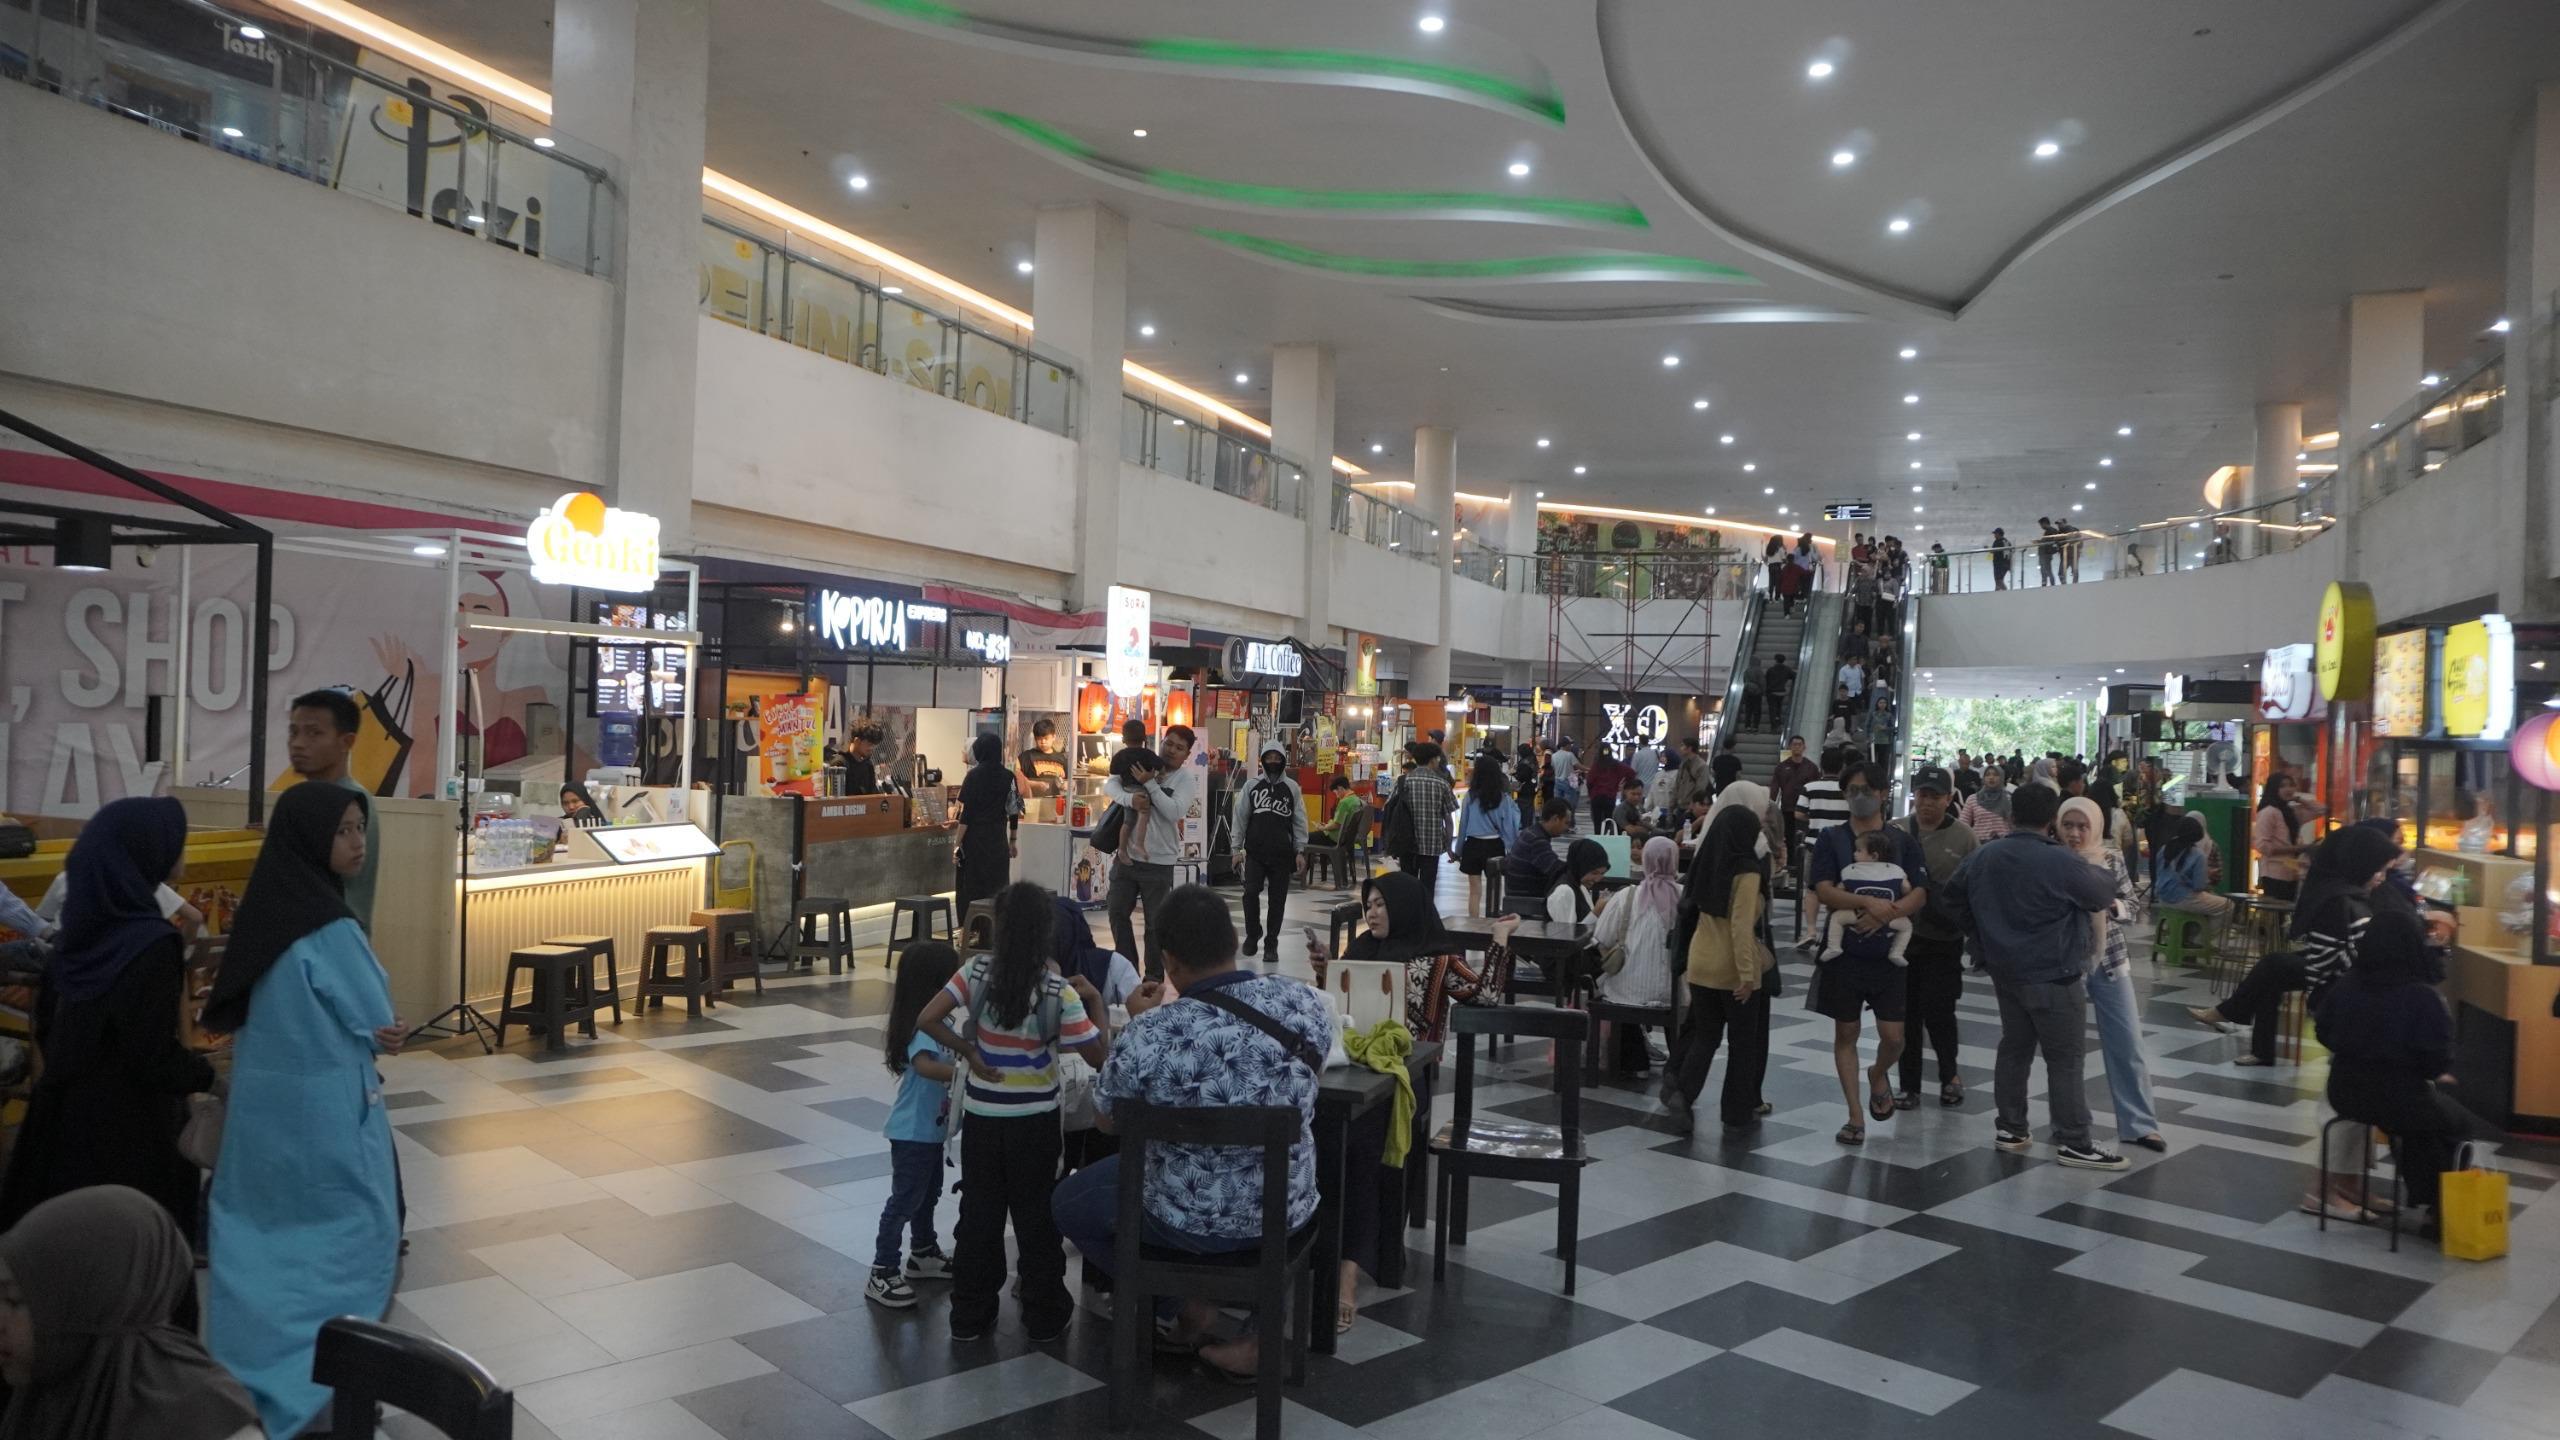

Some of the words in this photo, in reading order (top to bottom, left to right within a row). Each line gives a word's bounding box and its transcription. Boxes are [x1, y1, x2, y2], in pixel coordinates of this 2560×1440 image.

[822, 589, 906, 651] KOPIRIA
[1253, 645, 1267, 670] AL
[1270, 646, 1301, 674] Coffee
